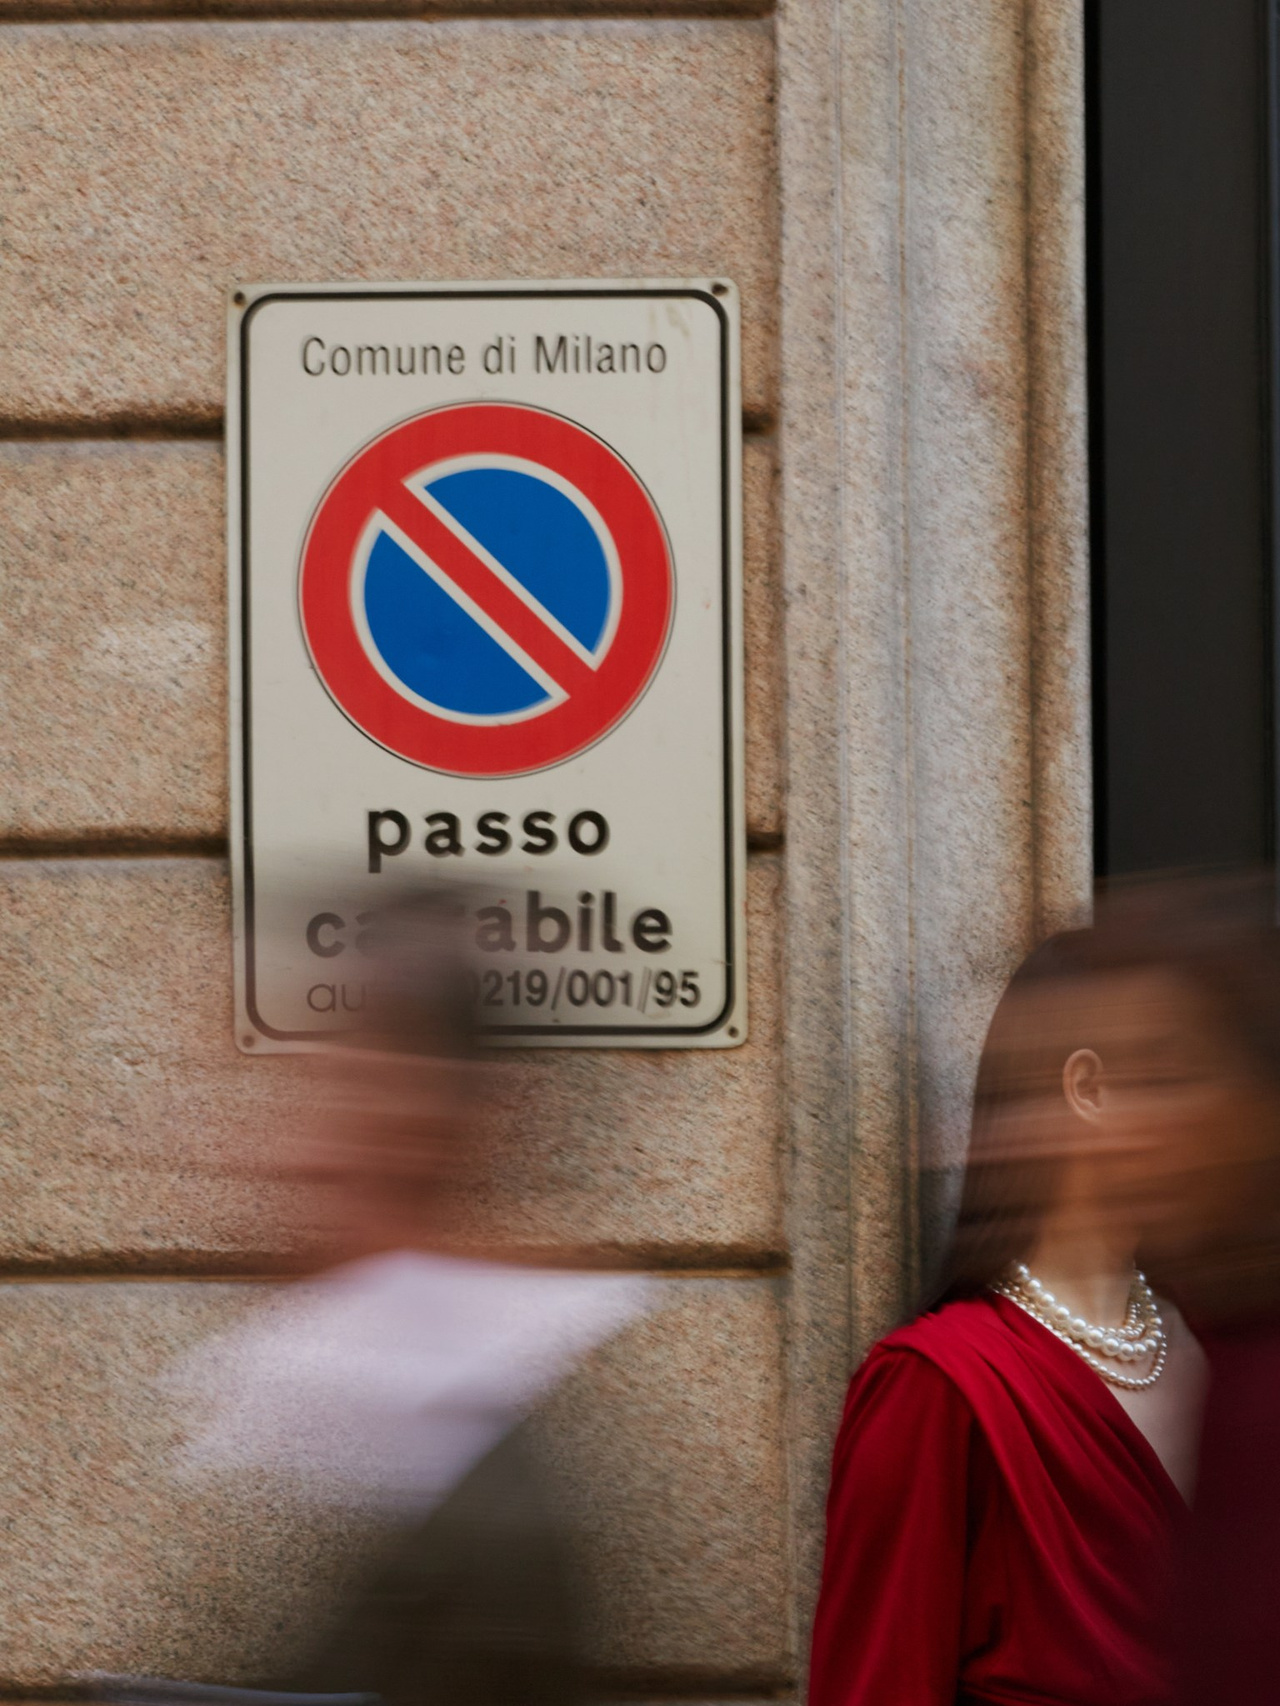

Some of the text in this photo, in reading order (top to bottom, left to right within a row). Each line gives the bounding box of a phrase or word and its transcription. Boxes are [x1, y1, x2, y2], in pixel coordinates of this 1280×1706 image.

[301, 334, 668, 377] Comune di Milano
[366, 807, 611, 874] passo
